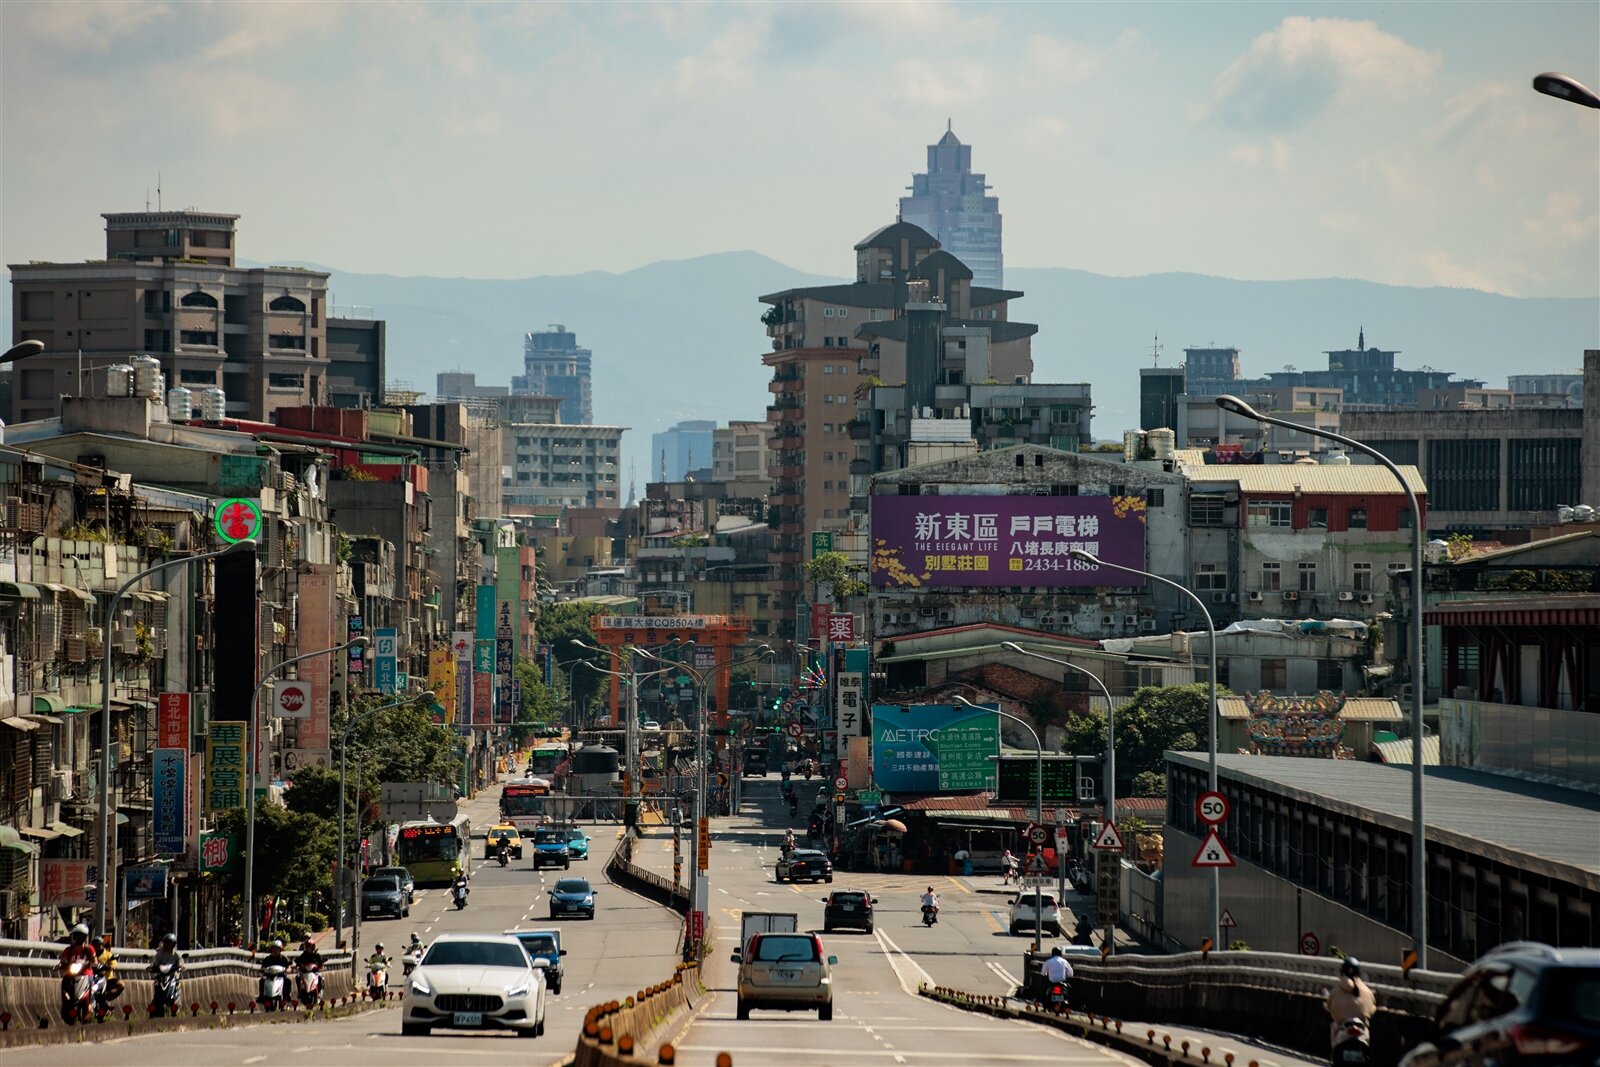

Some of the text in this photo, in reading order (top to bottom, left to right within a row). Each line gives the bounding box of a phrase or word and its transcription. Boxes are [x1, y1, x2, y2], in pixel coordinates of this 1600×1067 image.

[915, 512, 998, 541] 新東區
[1009, 515, 1099, 537] 戶戶電梯
[915, 543, 998, 551] THE ELEGANT LIFE
[925, 555, 989, 571] 別墅莊園
[280, 695, 304, 706] SYM
[167, 695, 181, 746] 台北市都
[881, 729, 939, 742] METRO
[897, 751, 931, 759] 國泰建設
[951, 771, 982, 780] 高速公路
[1203, 802, 1223, 815] 50
[1032, 831, 1045, 840] 50
[43, 863, 84, 902] 機車
[1305, 940, 1315, 949] 50
